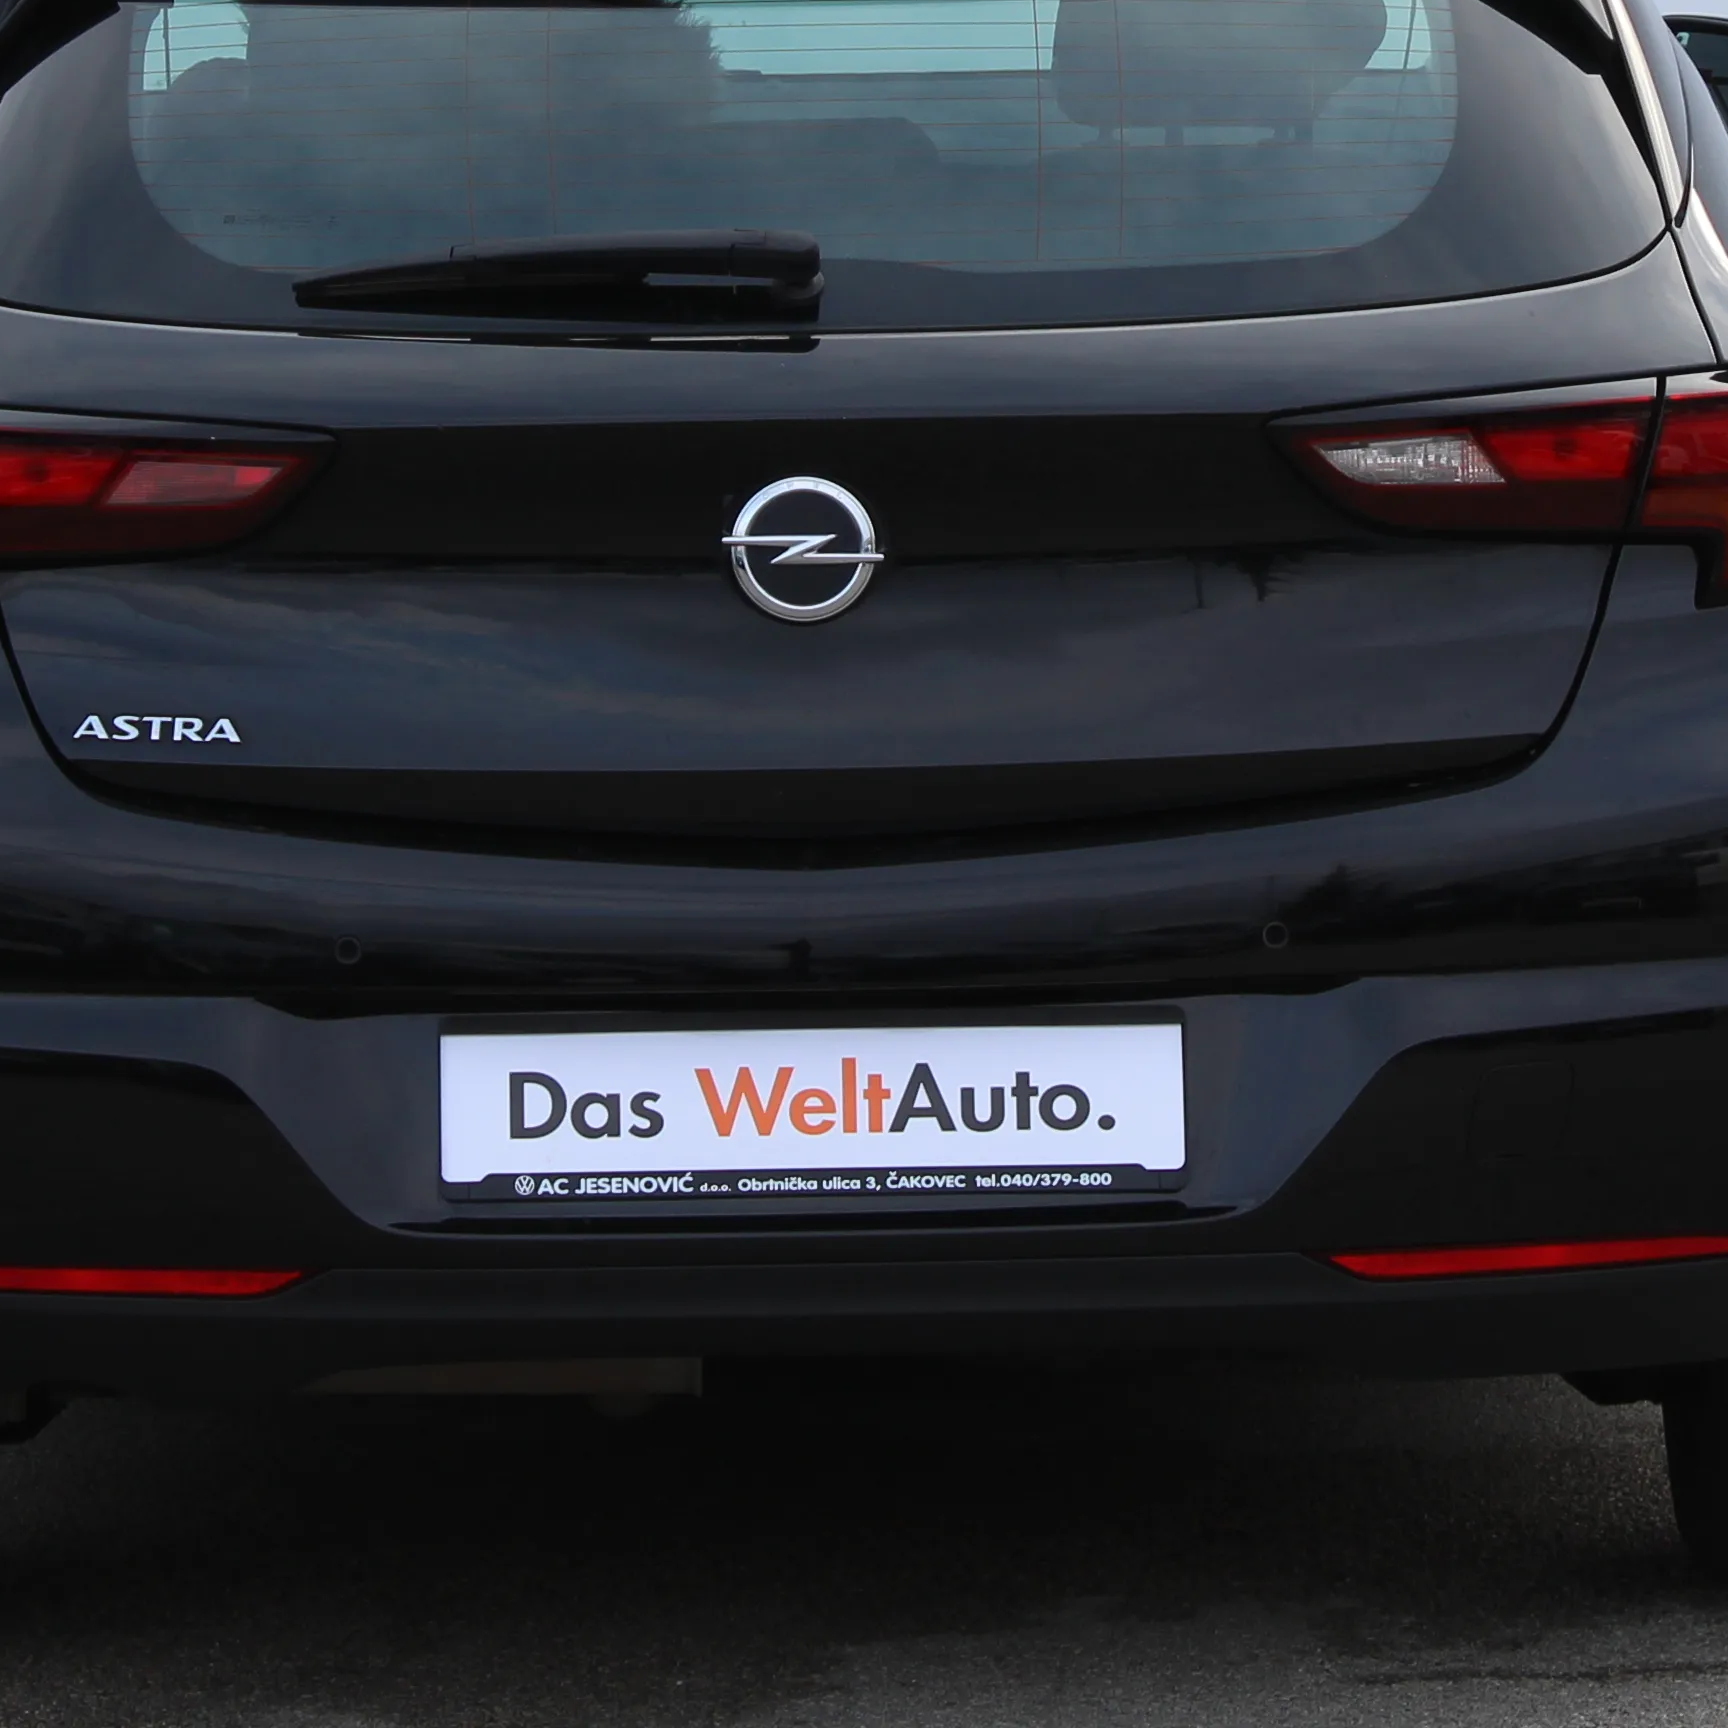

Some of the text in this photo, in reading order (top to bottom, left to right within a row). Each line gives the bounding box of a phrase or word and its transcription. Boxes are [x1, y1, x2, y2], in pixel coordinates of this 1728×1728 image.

[73, 715, 241, 743] ASTRA
[508, 1057, 1117, 1140] Das WeltAuto.
[537, 1178, 570, 1196] AC
[575, 1172, 694, 1195] JESENOVIĆ
[699, 1182, 732, 1193] d.o.o.
[737, 1177, 818, 1192] Obrtnička
[822, 1176, 861, 1191] ulica
[865, 1176, 882, 1192] 3,
[885, 1171, 967, 1190] ČAKOVEC
[974, 1172, 1113, 1189] tel.040/379-800
